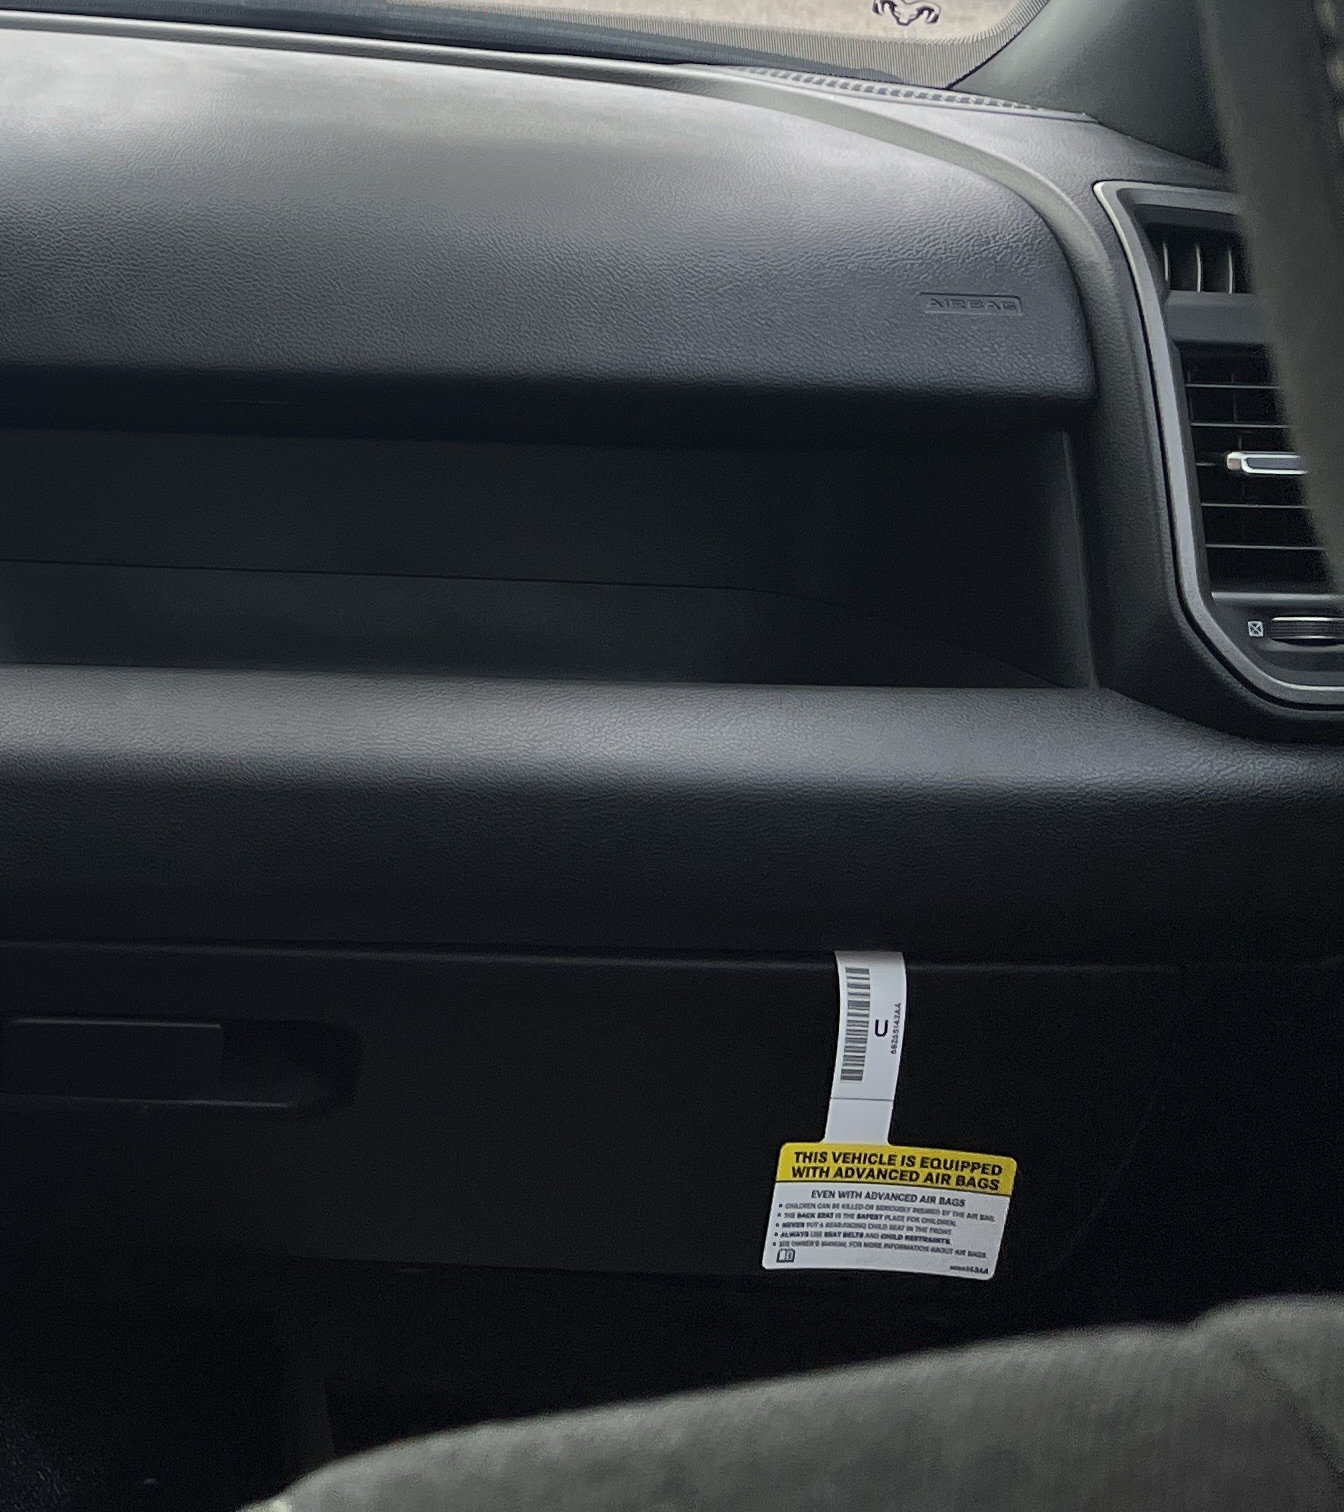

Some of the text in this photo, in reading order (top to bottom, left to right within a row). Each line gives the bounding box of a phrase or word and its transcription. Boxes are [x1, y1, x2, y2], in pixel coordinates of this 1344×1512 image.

[925, 297, 1019, 312] AIRBAG
[875, 1019, 888, 1037] U
[794, 1151, 1003, 1176] THIS VEHICLE IS EQUIPPED
[791, 1166, 1000, 1191] WITH ADVANCED AIR BAGS
[811, 1190, 966, 1207] EVEN WITH ADVANCED AIR BAGS
